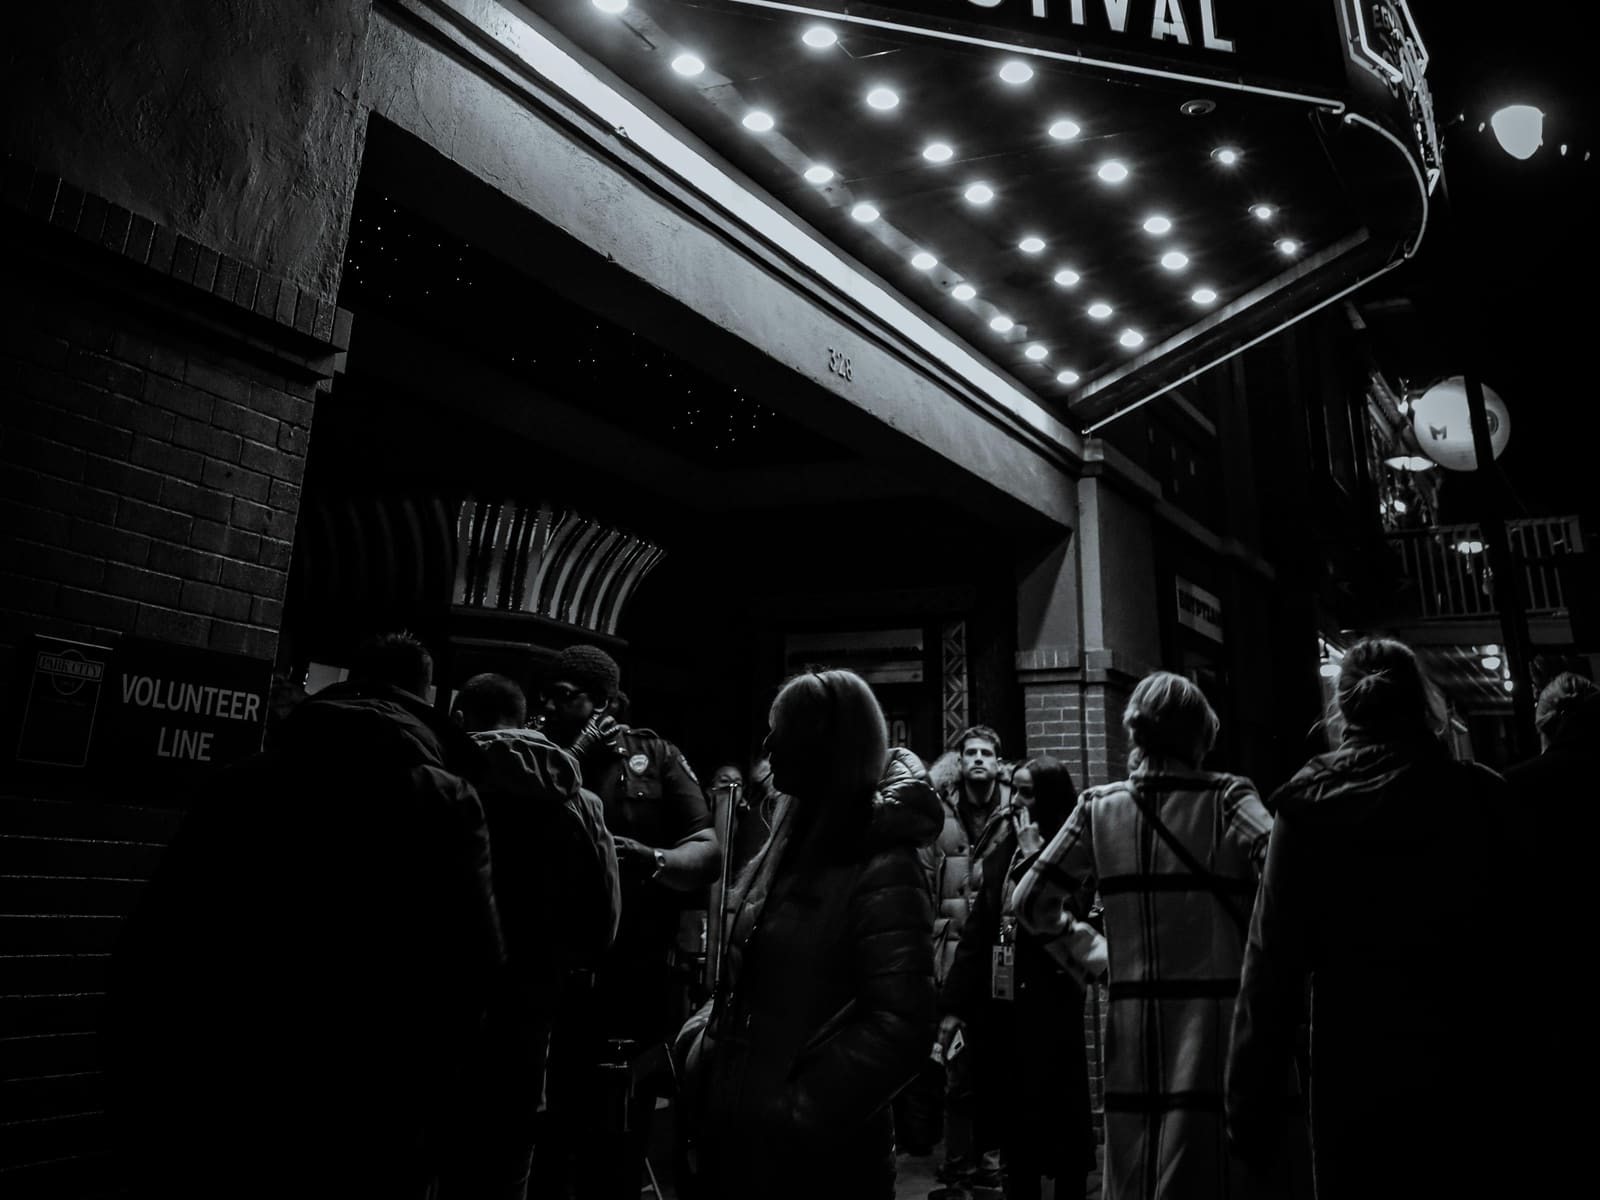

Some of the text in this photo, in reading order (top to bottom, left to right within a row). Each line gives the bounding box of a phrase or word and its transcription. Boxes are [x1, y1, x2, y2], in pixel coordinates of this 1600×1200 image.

[827, 347, 853, 382] 328
[122, 672, 261, 722] VOLUNTEER
[156, 726, 215, 762] LINE
